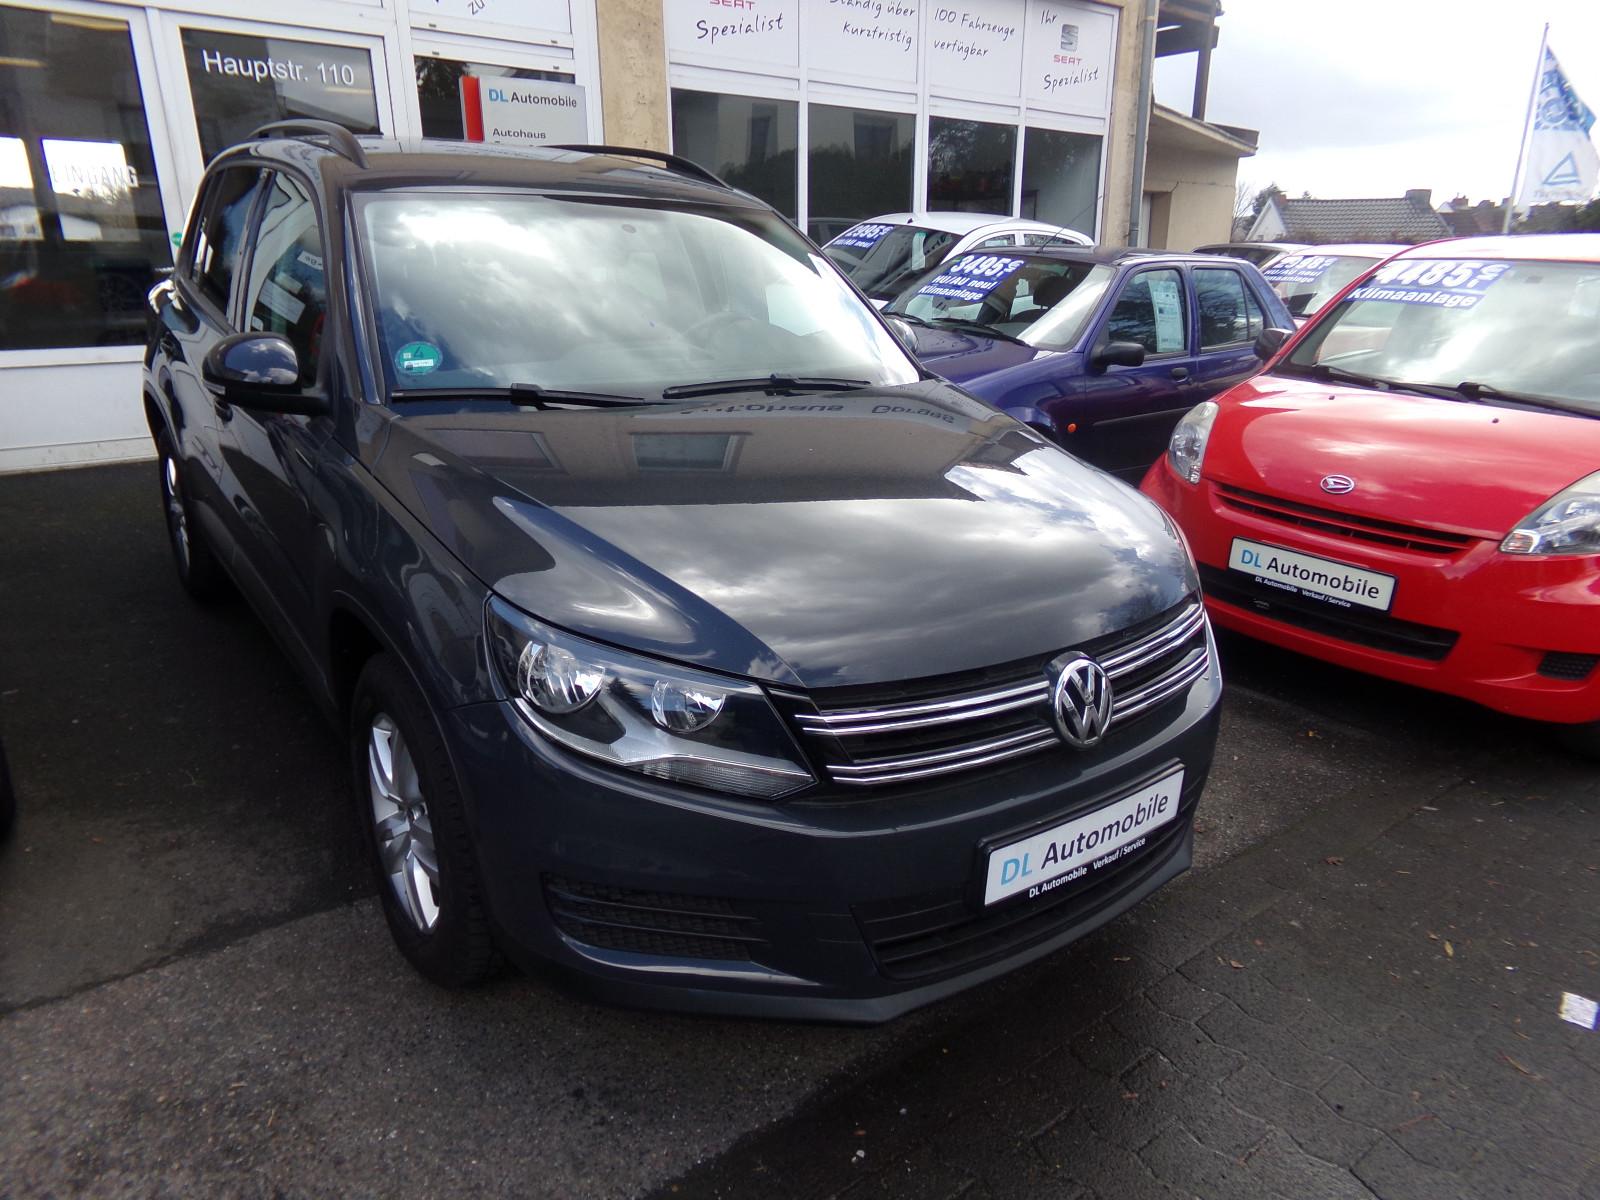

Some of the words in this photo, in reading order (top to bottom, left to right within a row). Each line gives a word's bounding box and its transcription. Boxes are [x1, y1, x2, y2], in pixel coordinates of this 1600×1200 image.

[696, 12, 784, 44] Spezialist
[934, 8, 957, 23] 100
[961, 13, 1015, 42] Fahrzeuge
[1041, 9, 1058, 25] Ihr
[934, 39, 989, 61] verfügbar
[1053, 54, 1083, 66] SEAT
[202, 49, 309, 83] Hauptstr.
[317, 61, 355, 86] 110
[1043, 66, 1099, 94] Spezialist
[489, 88, 509, 103] DL
[511, 91, 577, 108] Automobile
[493, 127, 547, 140] Autohaus
[918, 285, 984, 301] Klimaanlage
[1347, 287, 1479, 309] Klimaanlage
[1240, 550, 1262, 568] DL
[1266, 557, 1380, 599] Automobile
[1000, 853, 1033, 886] DL
[1040, 793, 1169, 870] Automobile
[1029, 886, 1040, 899] DL
[1040, 866, 1088, 893] Automobile
[1093, 849, 1120, 870] Verkauf
[1123, 838, 1146, 855] Service
